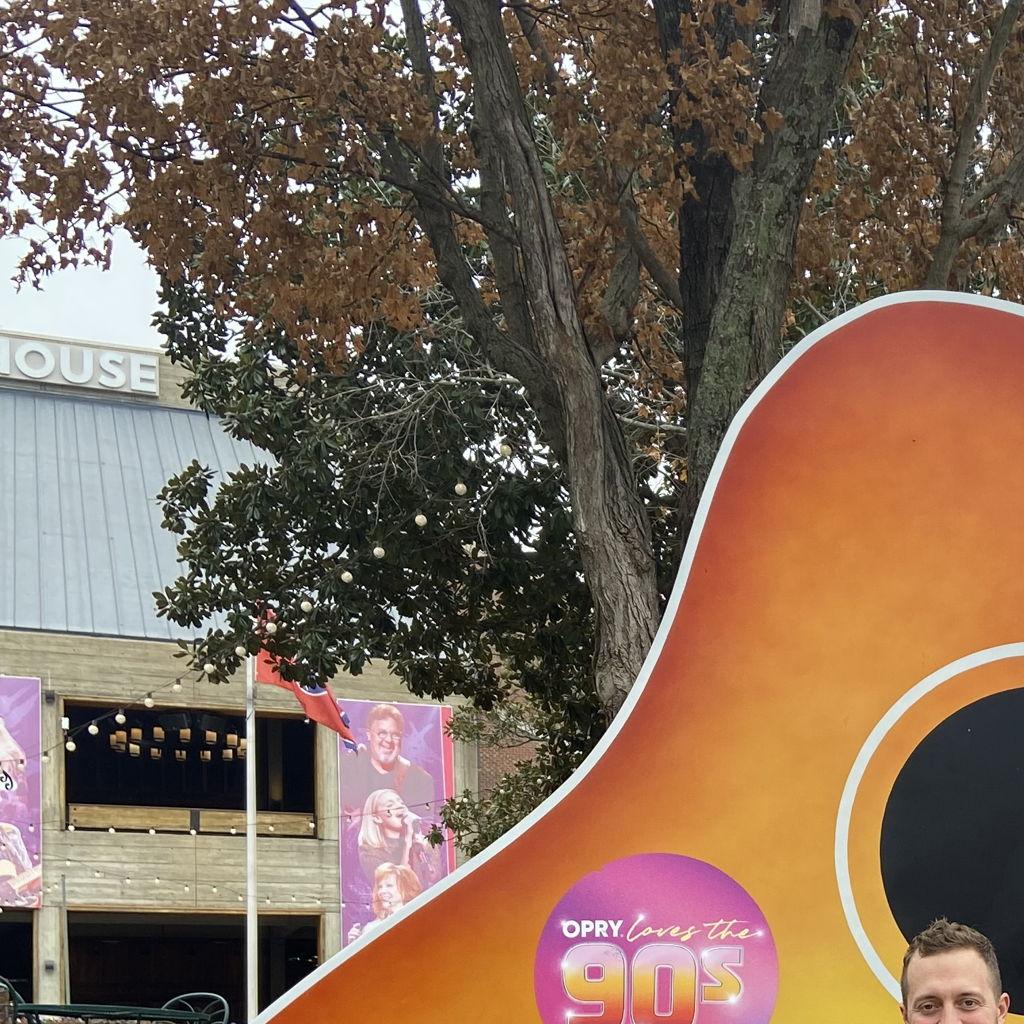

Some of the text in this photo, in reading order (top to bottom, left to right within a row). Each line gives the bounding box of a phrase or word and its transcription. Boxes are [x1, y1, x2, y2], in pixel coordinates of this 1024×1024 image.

[0, 337, 156, 391] OUSE
[562, 914, 763, 942] OPRY loves the
